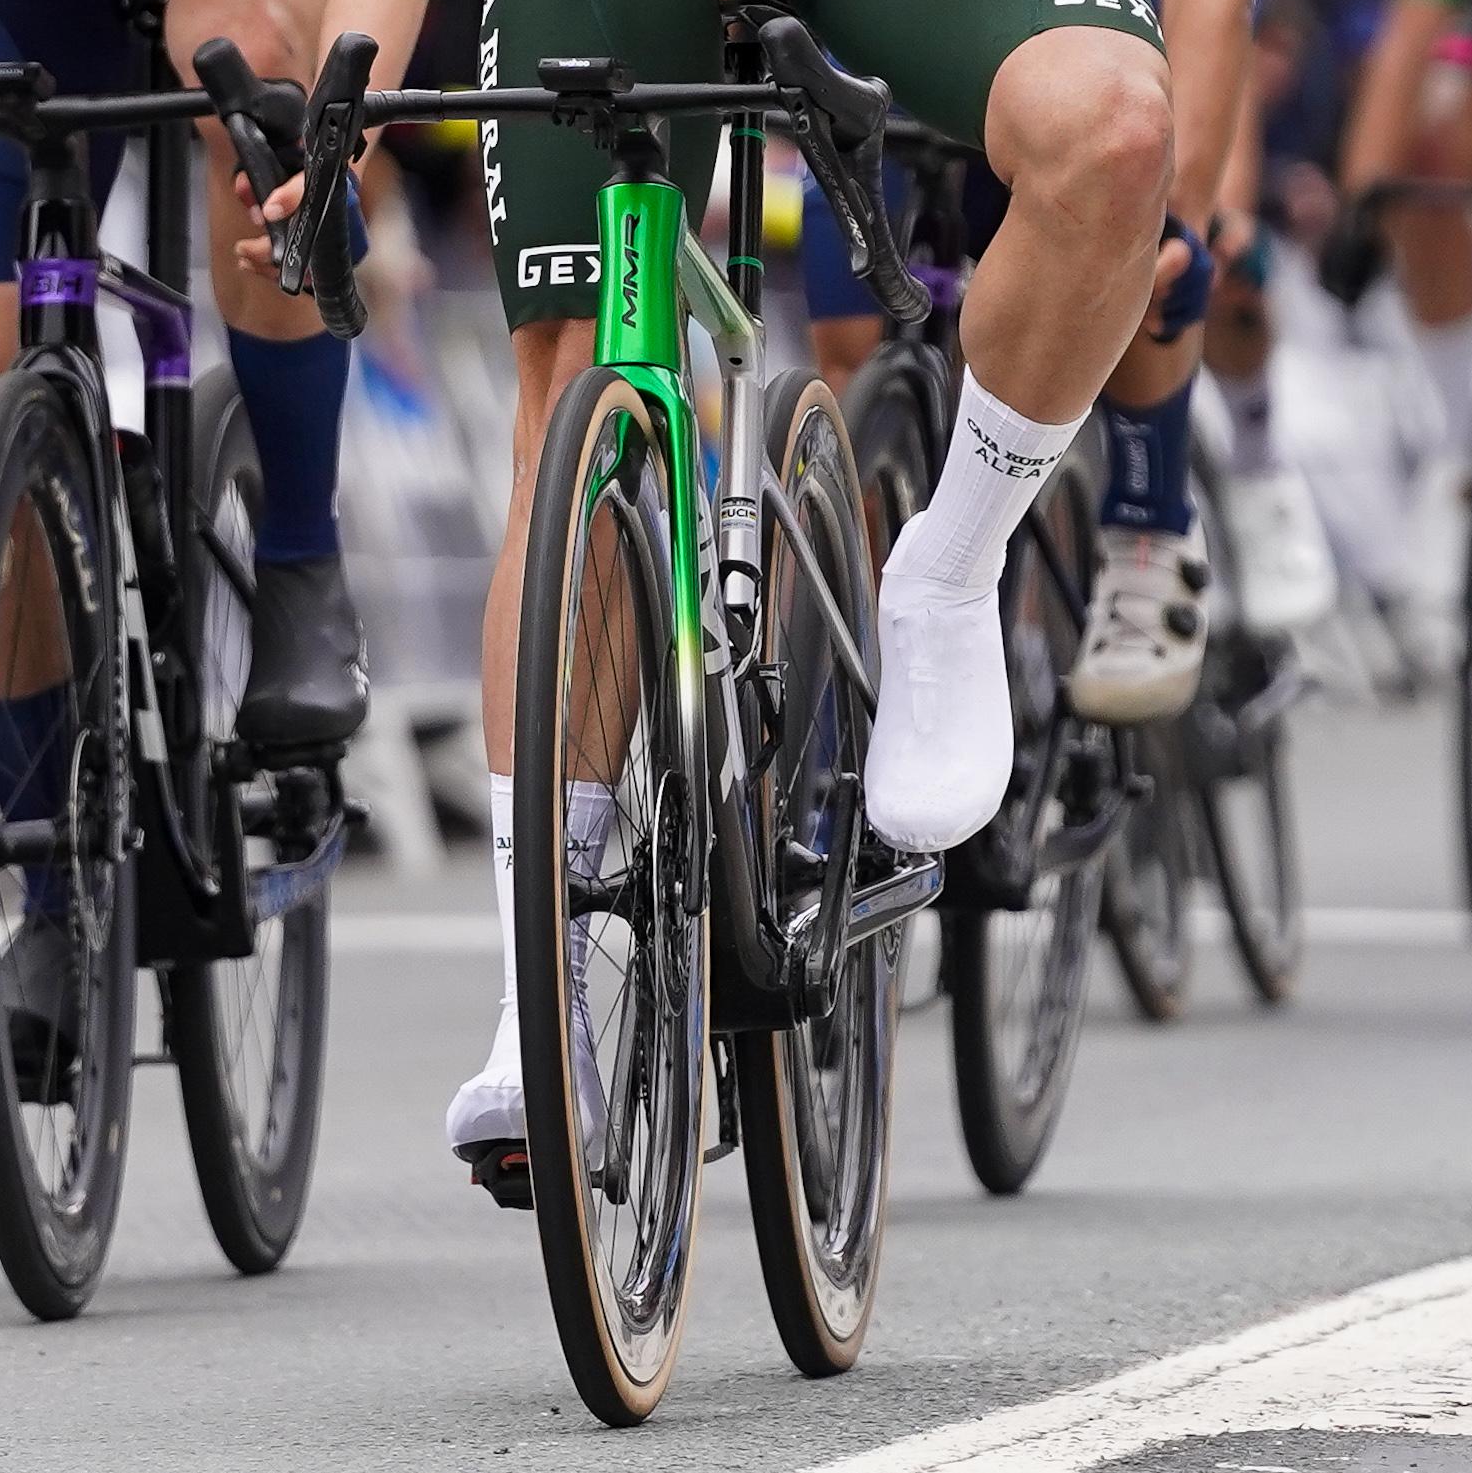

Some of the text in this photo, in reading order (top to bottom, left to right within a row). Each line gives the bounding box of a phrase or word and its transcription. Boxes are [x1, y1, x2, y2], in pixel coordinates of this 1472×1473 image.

[621, 213, 641, 328] MMR
[967, 417, 1001, 455] CAJA
[974, 445, 1042, 479] ALEA
[727, 508, 749, 518] UCI
